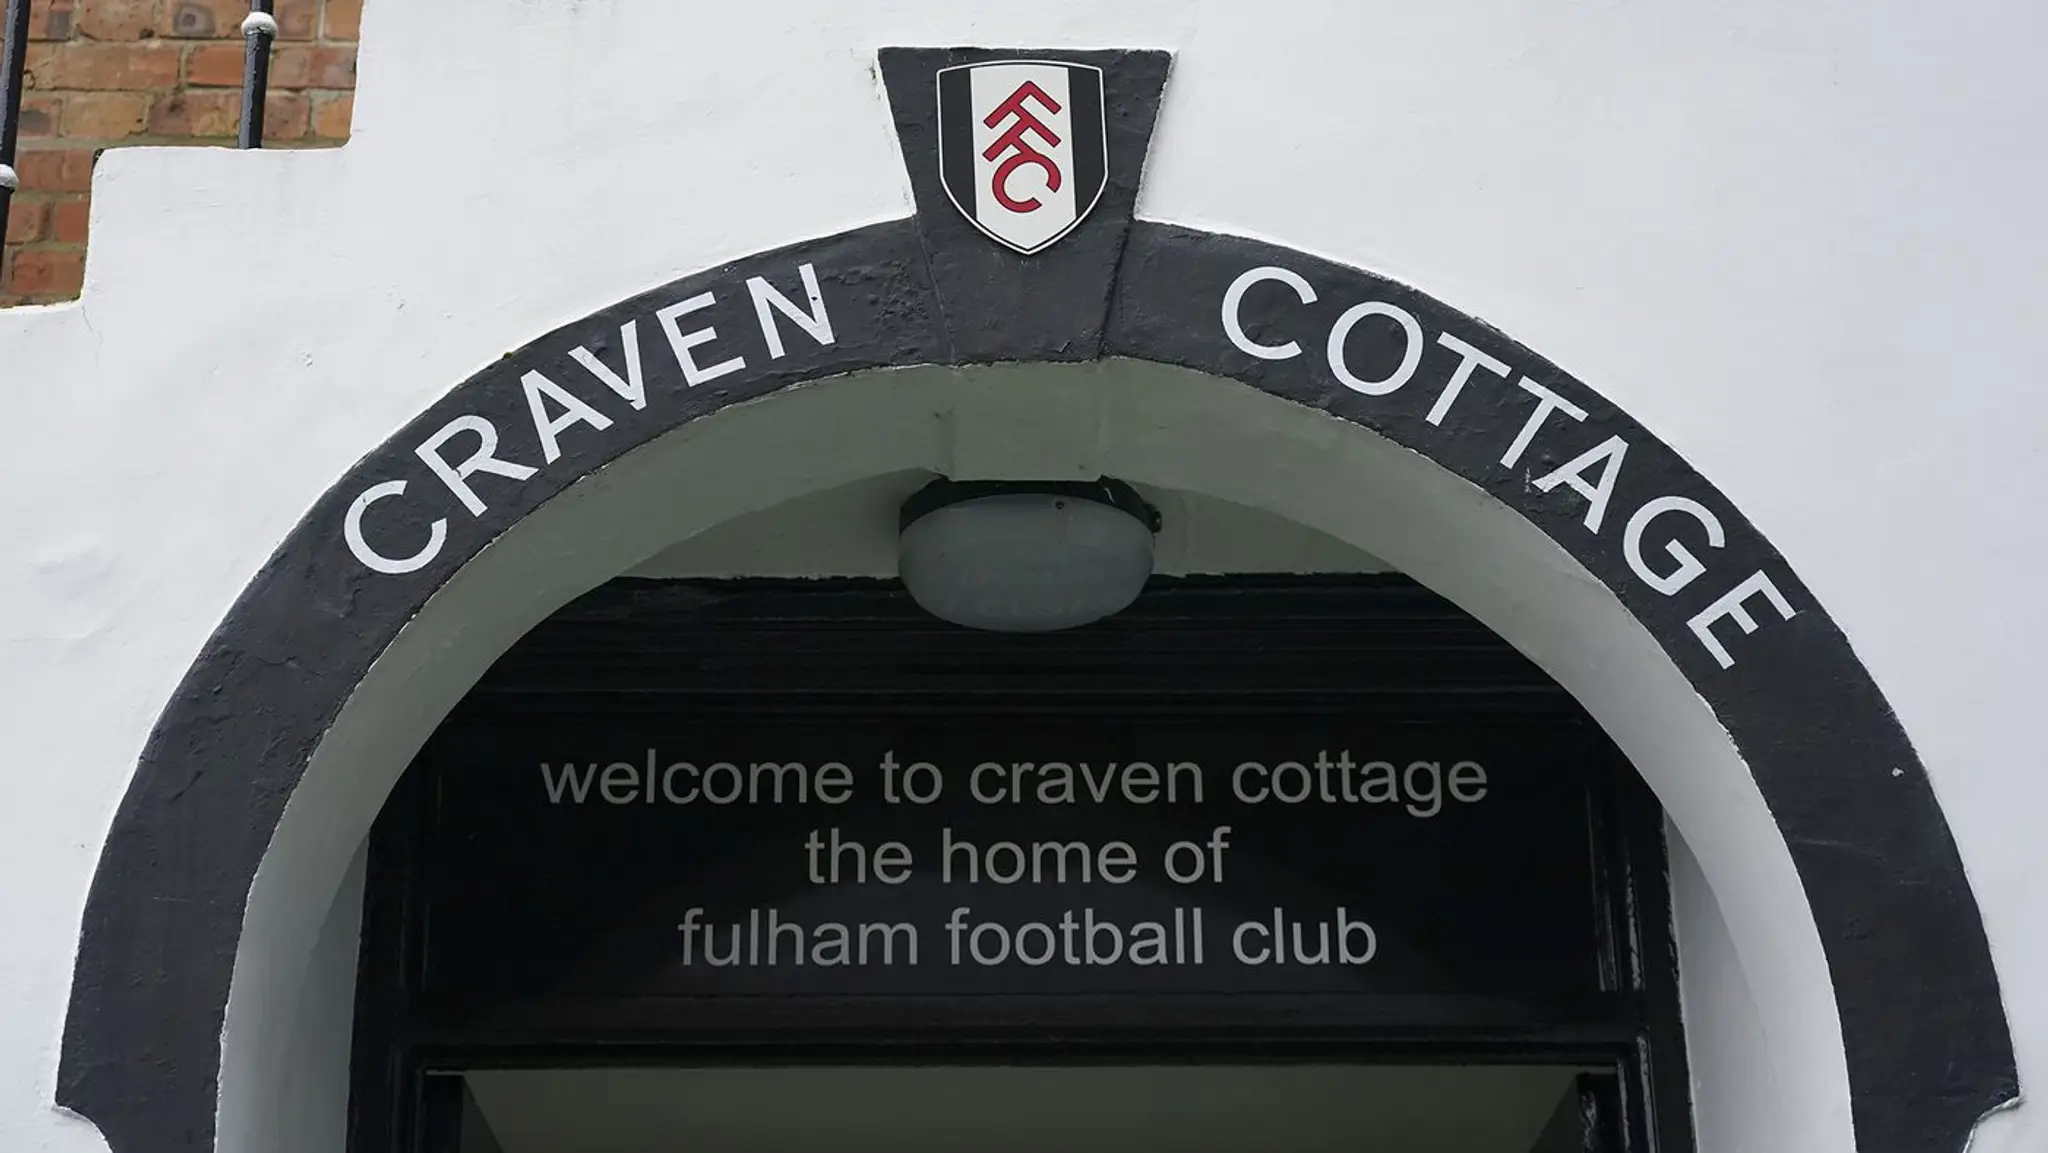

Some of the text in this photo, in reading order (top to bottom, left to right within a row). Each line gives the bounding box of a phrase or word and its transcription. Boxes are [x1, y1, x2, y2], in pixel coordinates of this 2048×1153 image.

[344, 263, 1796, 670] CRAVEN COTTAGE
[541, 749, 1488, 817] welcome to craven cottage
[805, 826, 1231, 884] the home of
[679, 907, 1377, 966] fulham football club
